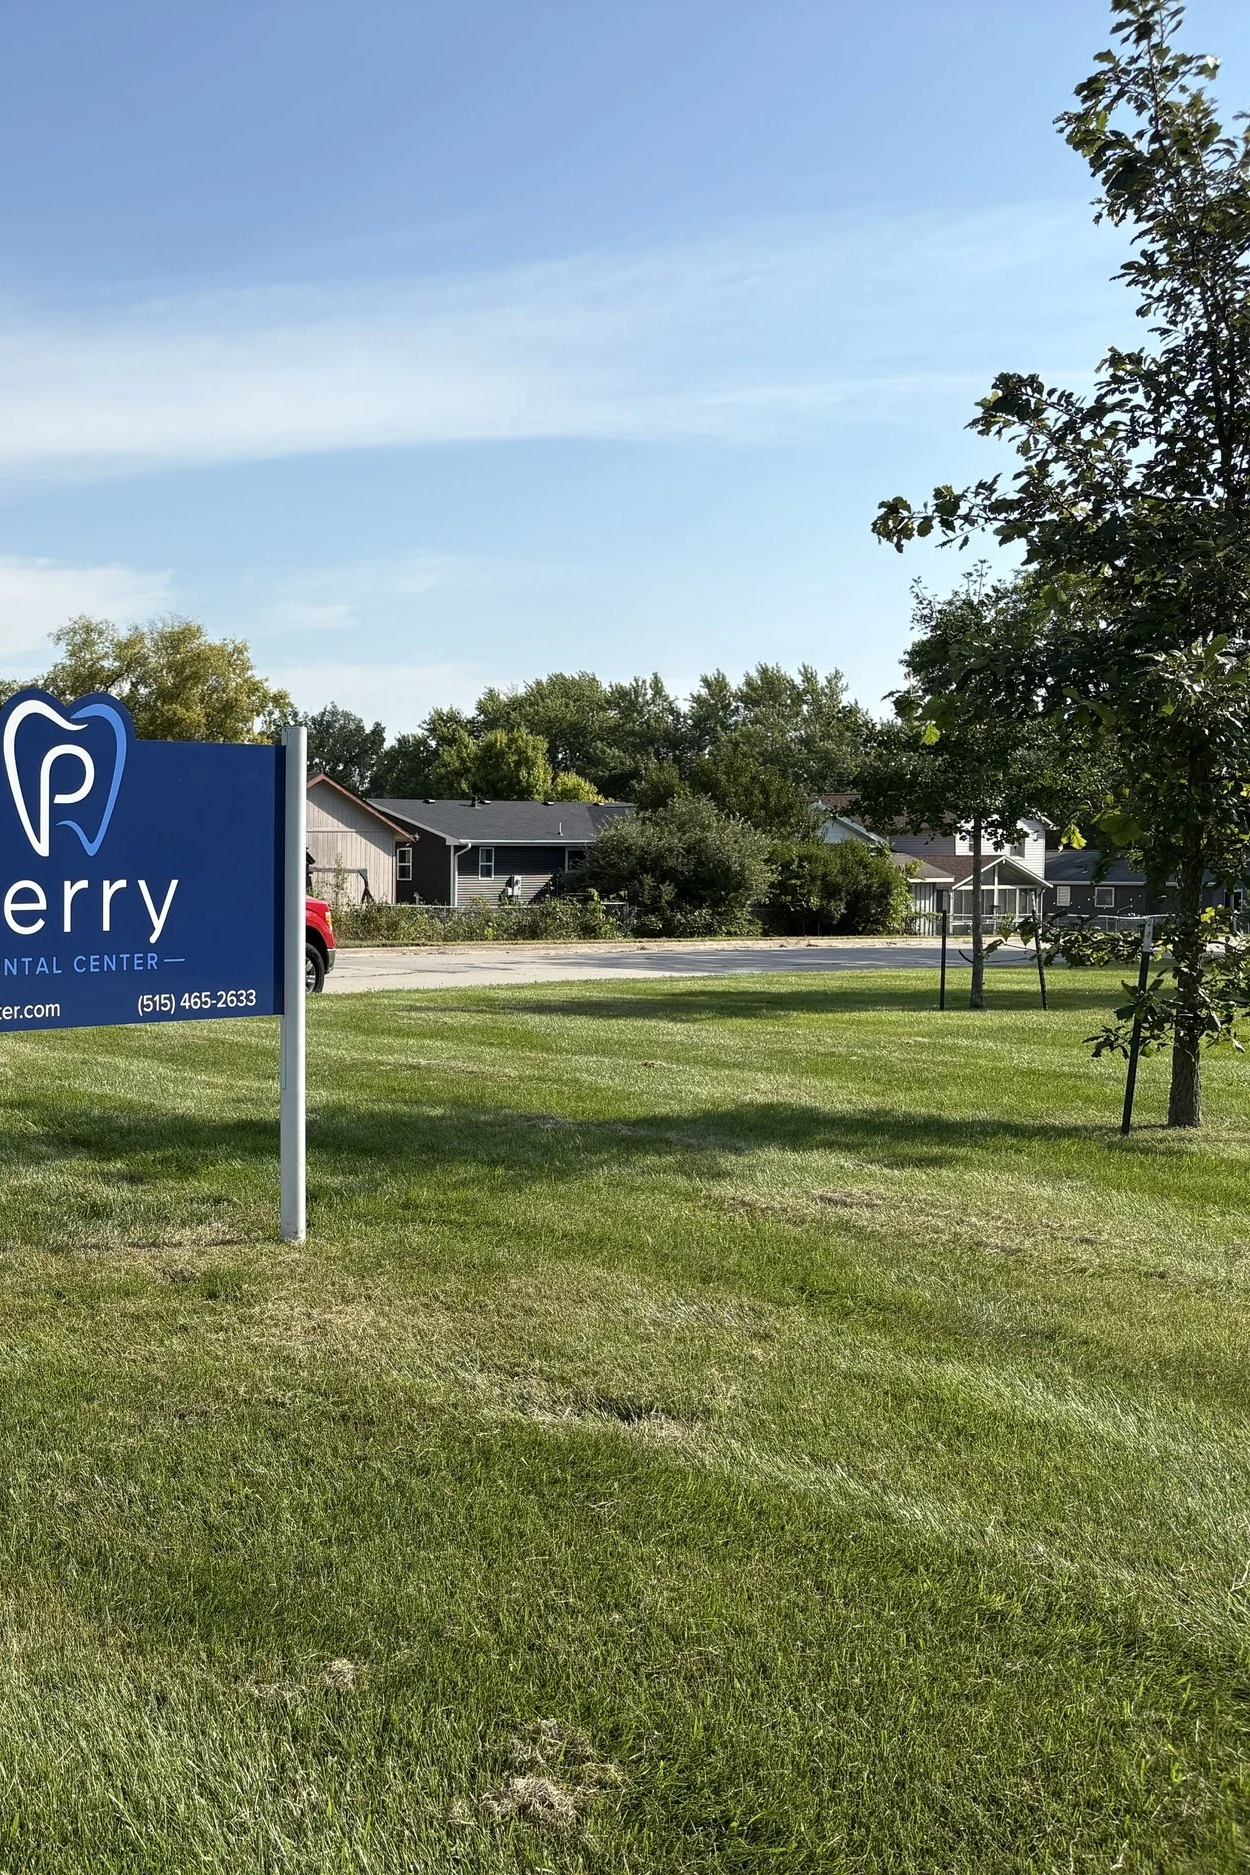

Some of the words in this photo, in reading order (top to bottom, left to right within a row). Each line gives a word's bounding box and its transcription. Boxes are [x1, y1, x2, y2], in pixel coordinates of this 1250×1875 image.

[73, 953, 159, 973] CENTER
[137, 993, 176, 1017] (515)
[179, 988, 257, 1010] 465-2633
